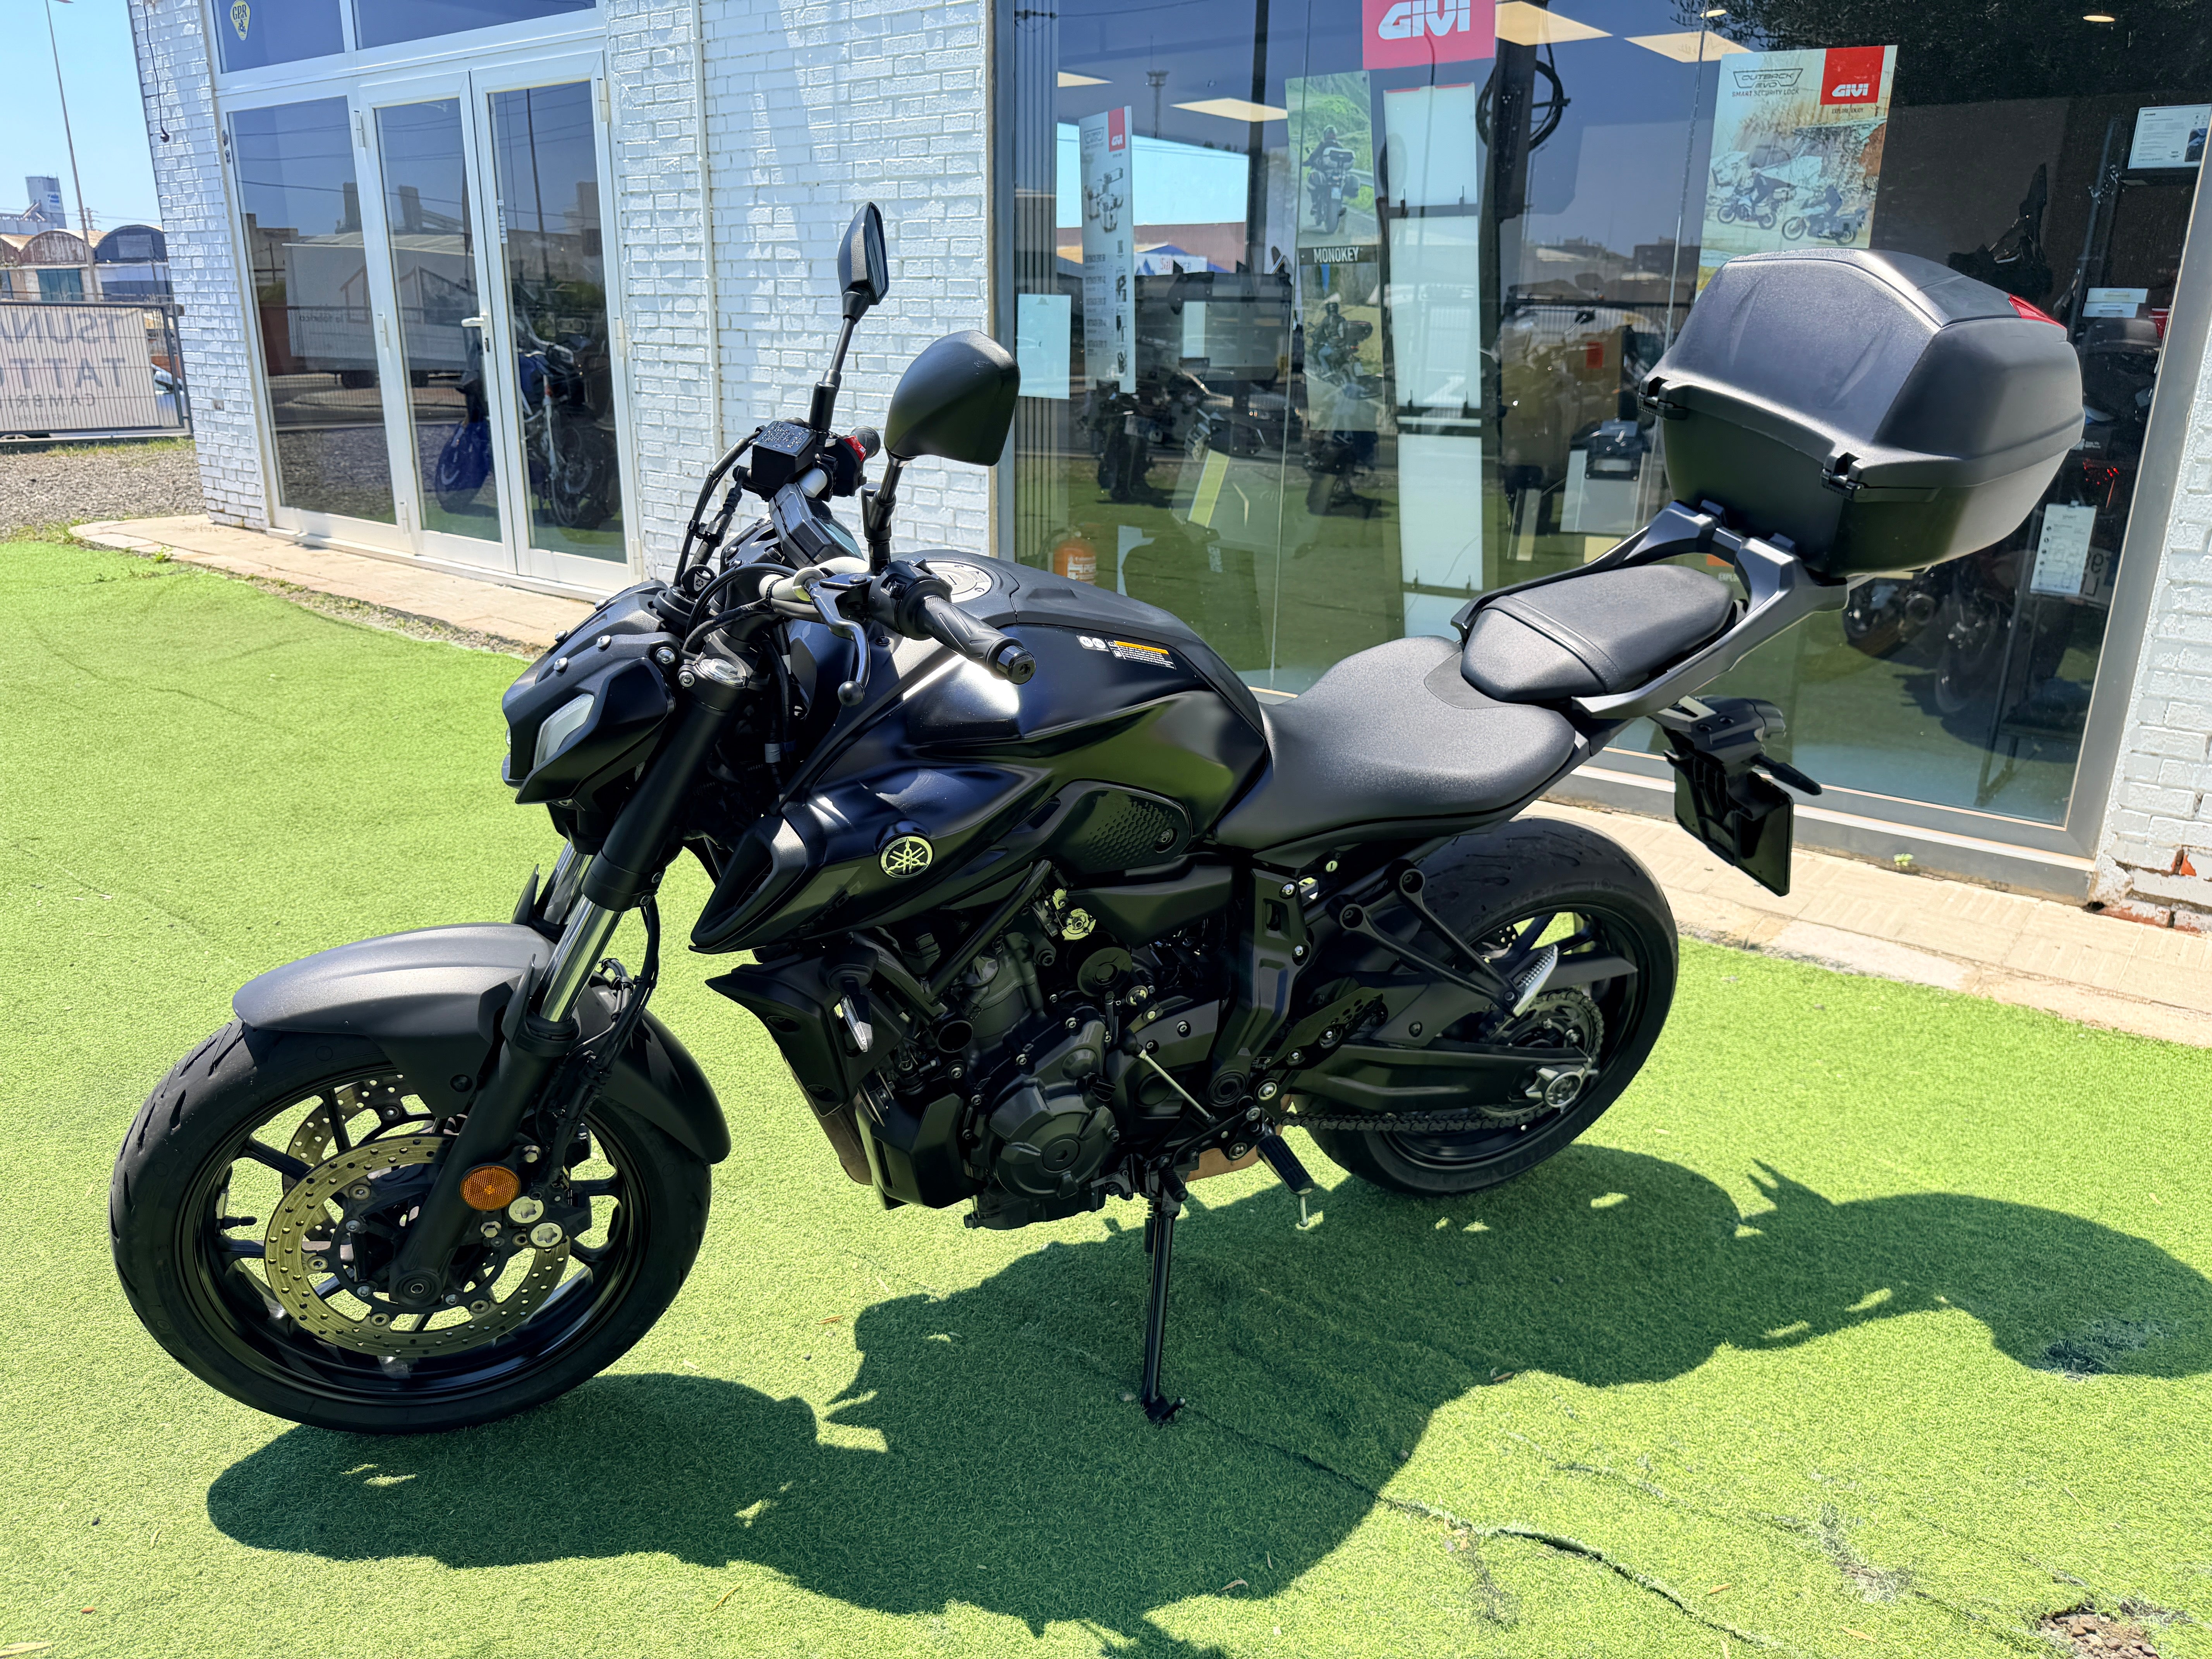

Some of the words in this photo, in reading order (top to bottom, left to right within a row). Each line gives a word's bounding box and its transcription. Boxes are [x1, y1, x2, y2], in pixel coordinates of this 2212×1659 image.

[232, 4, 247, 20] GPR
[1378, 0, 1470, 40] GIVI
[1832, 83, 1869, 97] GIVI
[1313, 246, 1359, 263] MONOKEY
